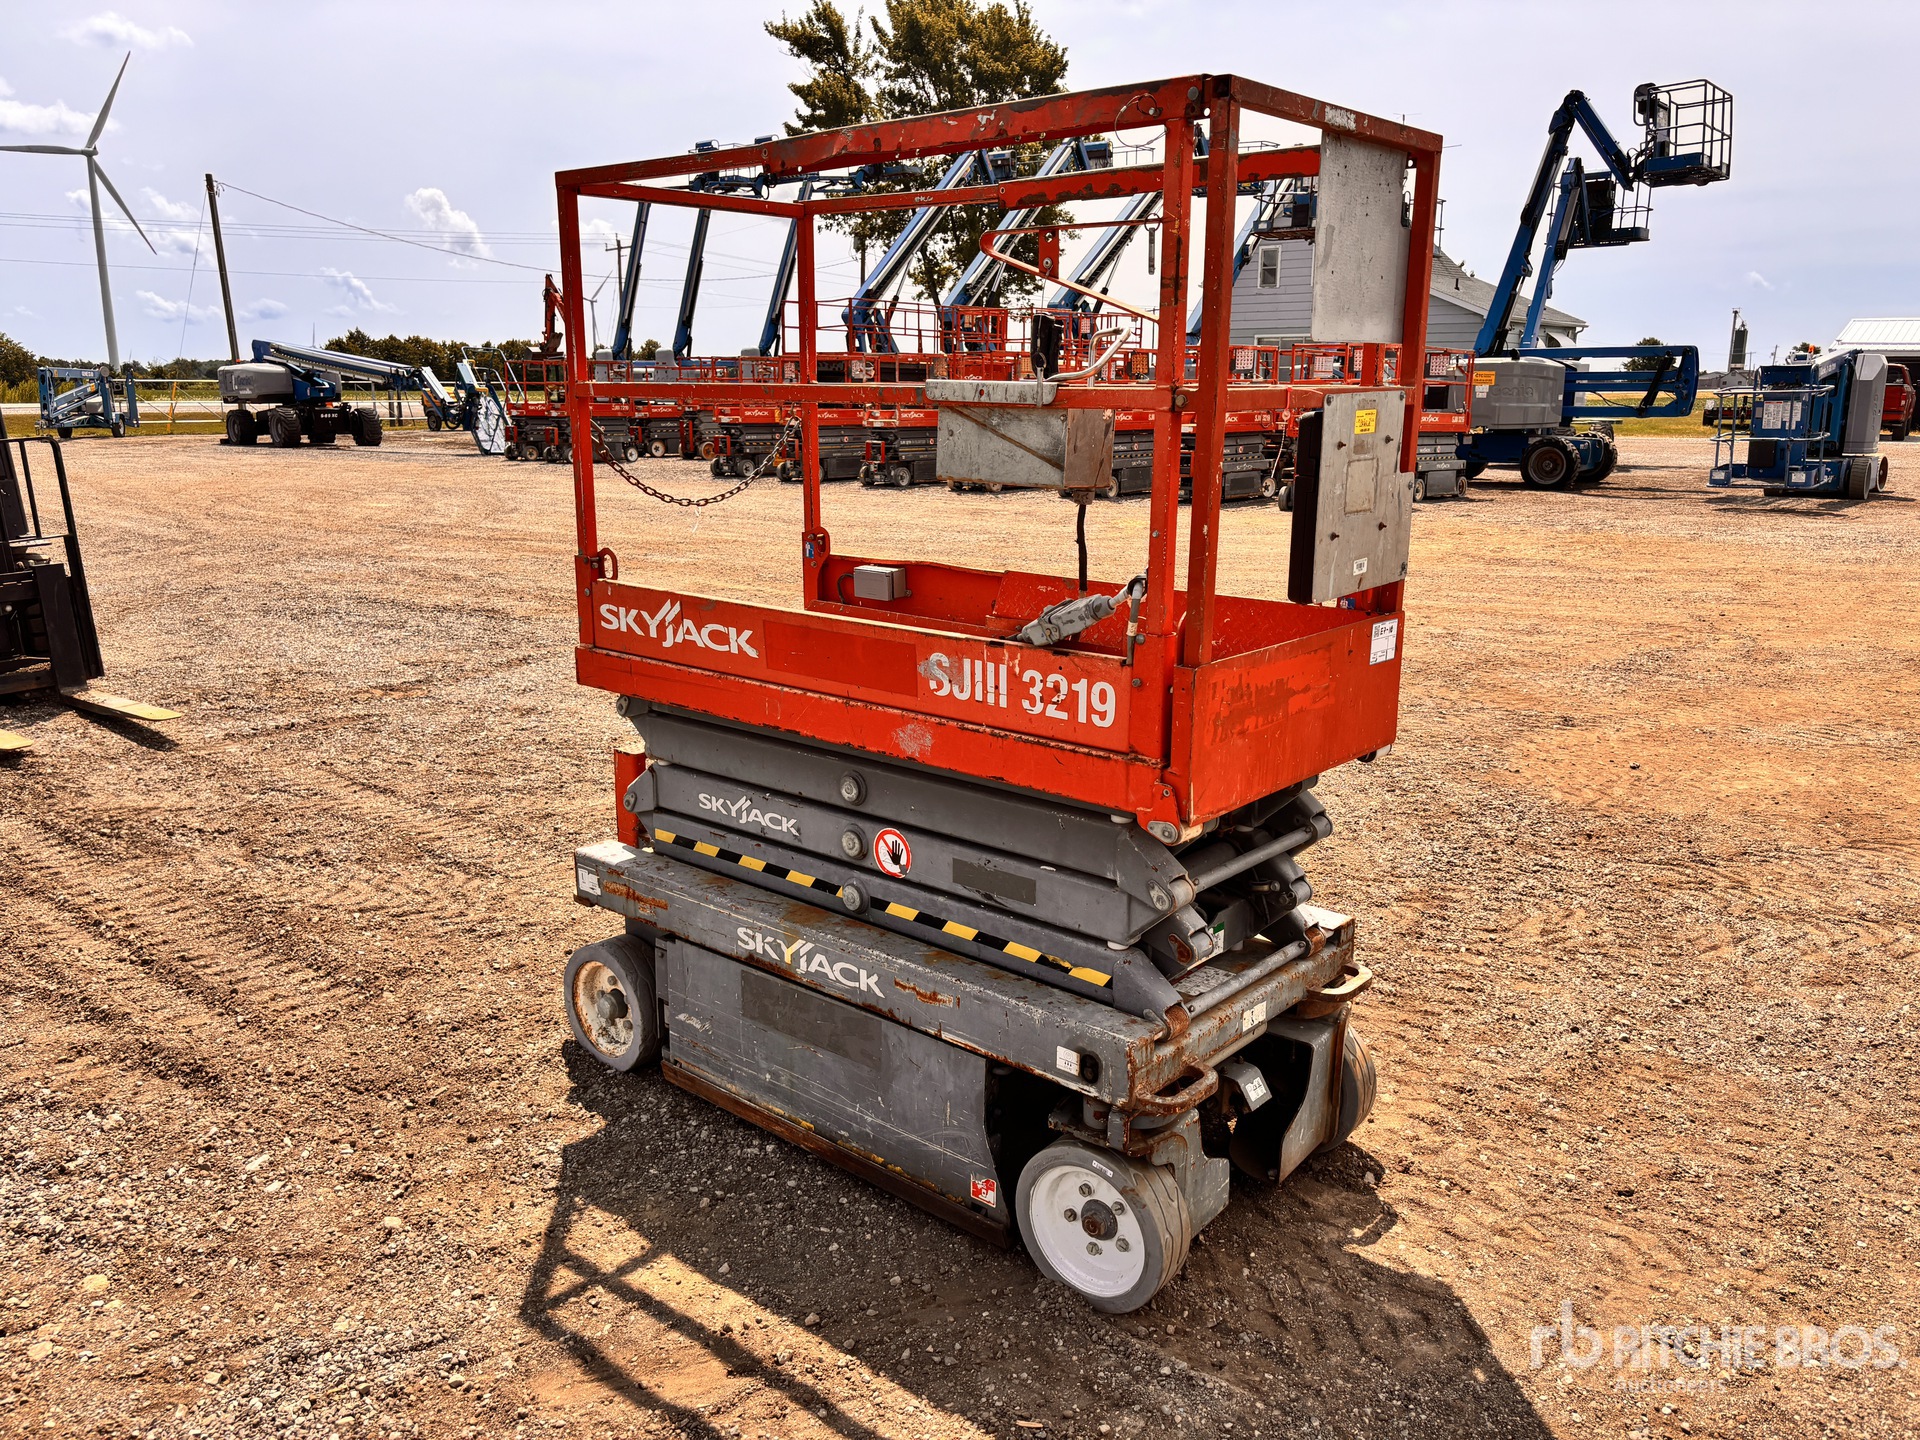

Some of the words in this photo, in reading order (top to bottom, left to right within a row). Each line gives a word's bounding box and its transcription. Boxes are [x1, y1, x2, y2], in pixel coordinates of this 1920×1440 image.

[744, 409, 769, 417] SKYJACK
[901, 411, 925, 419] SKYJACK
[599, 599, 759, 658] SKYJACK
[1021, 669, 1116, 728] 3219
[698, 793, 800, 837] SKYJACK
[736, 926, 886, 999] SKYJACK
